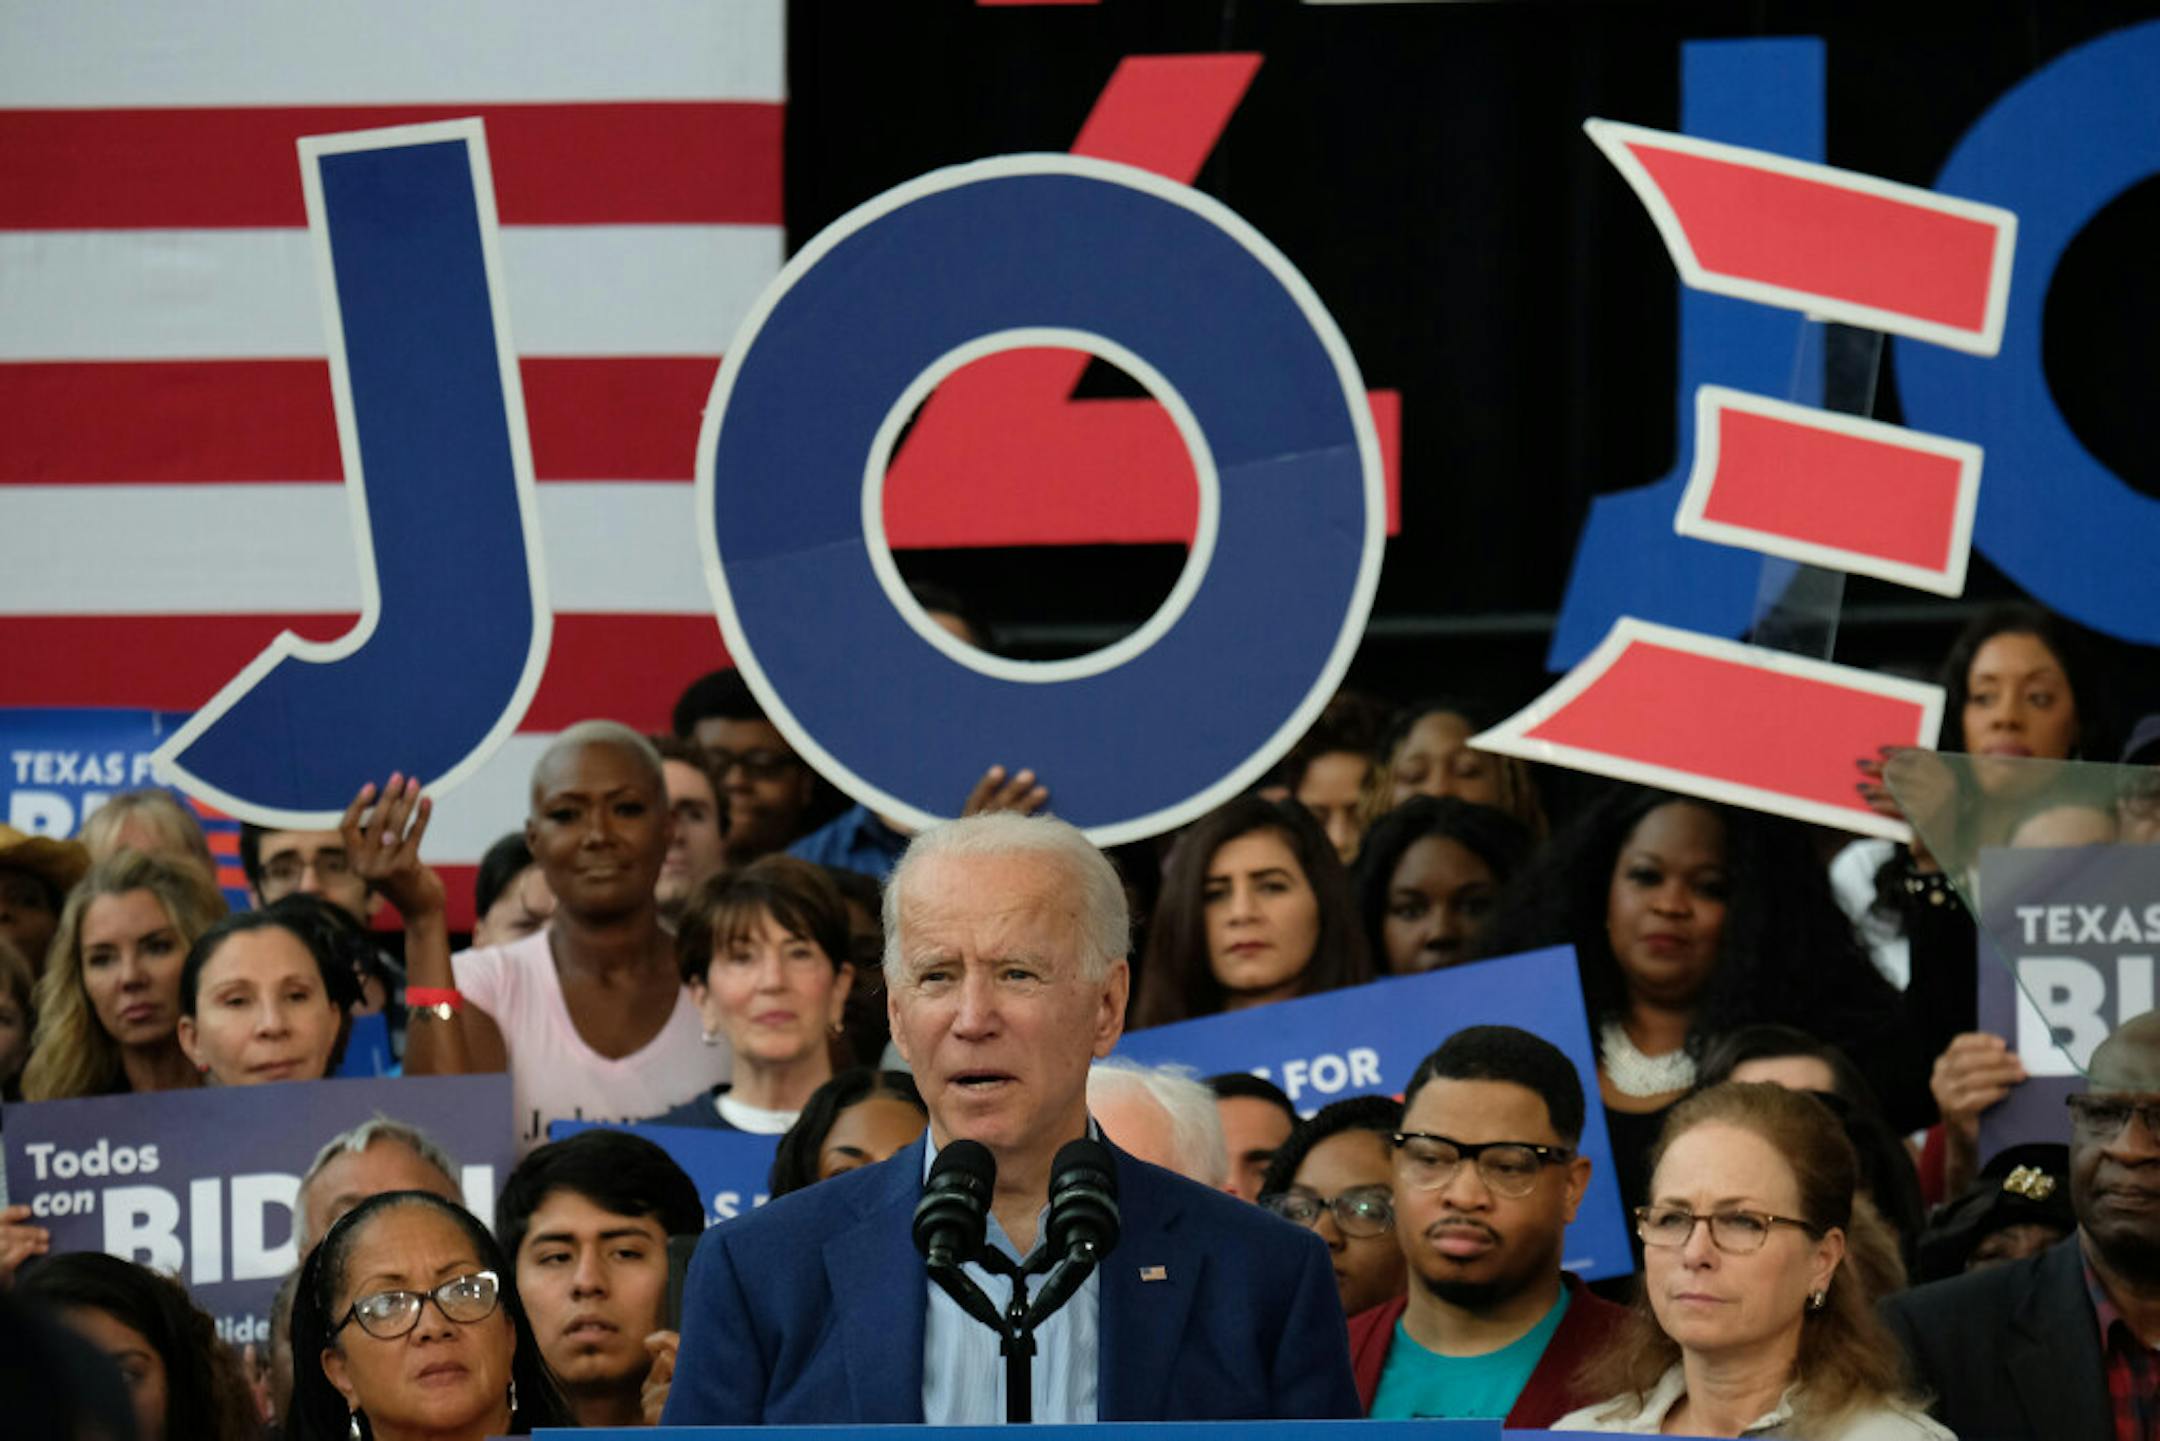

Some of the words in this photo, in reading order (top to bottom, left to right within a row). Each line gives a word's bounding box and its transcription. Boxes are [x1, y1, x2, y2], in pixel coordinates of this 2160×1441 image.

[11, 752, 125, 785] TEXAS
[2016, 905, 2160, 945] TEXAS
[1283, 1047, 1383, 1101] FOR
[25, 1138, 160, 1180] Todos
[32, 1190, 95, 1218] con
